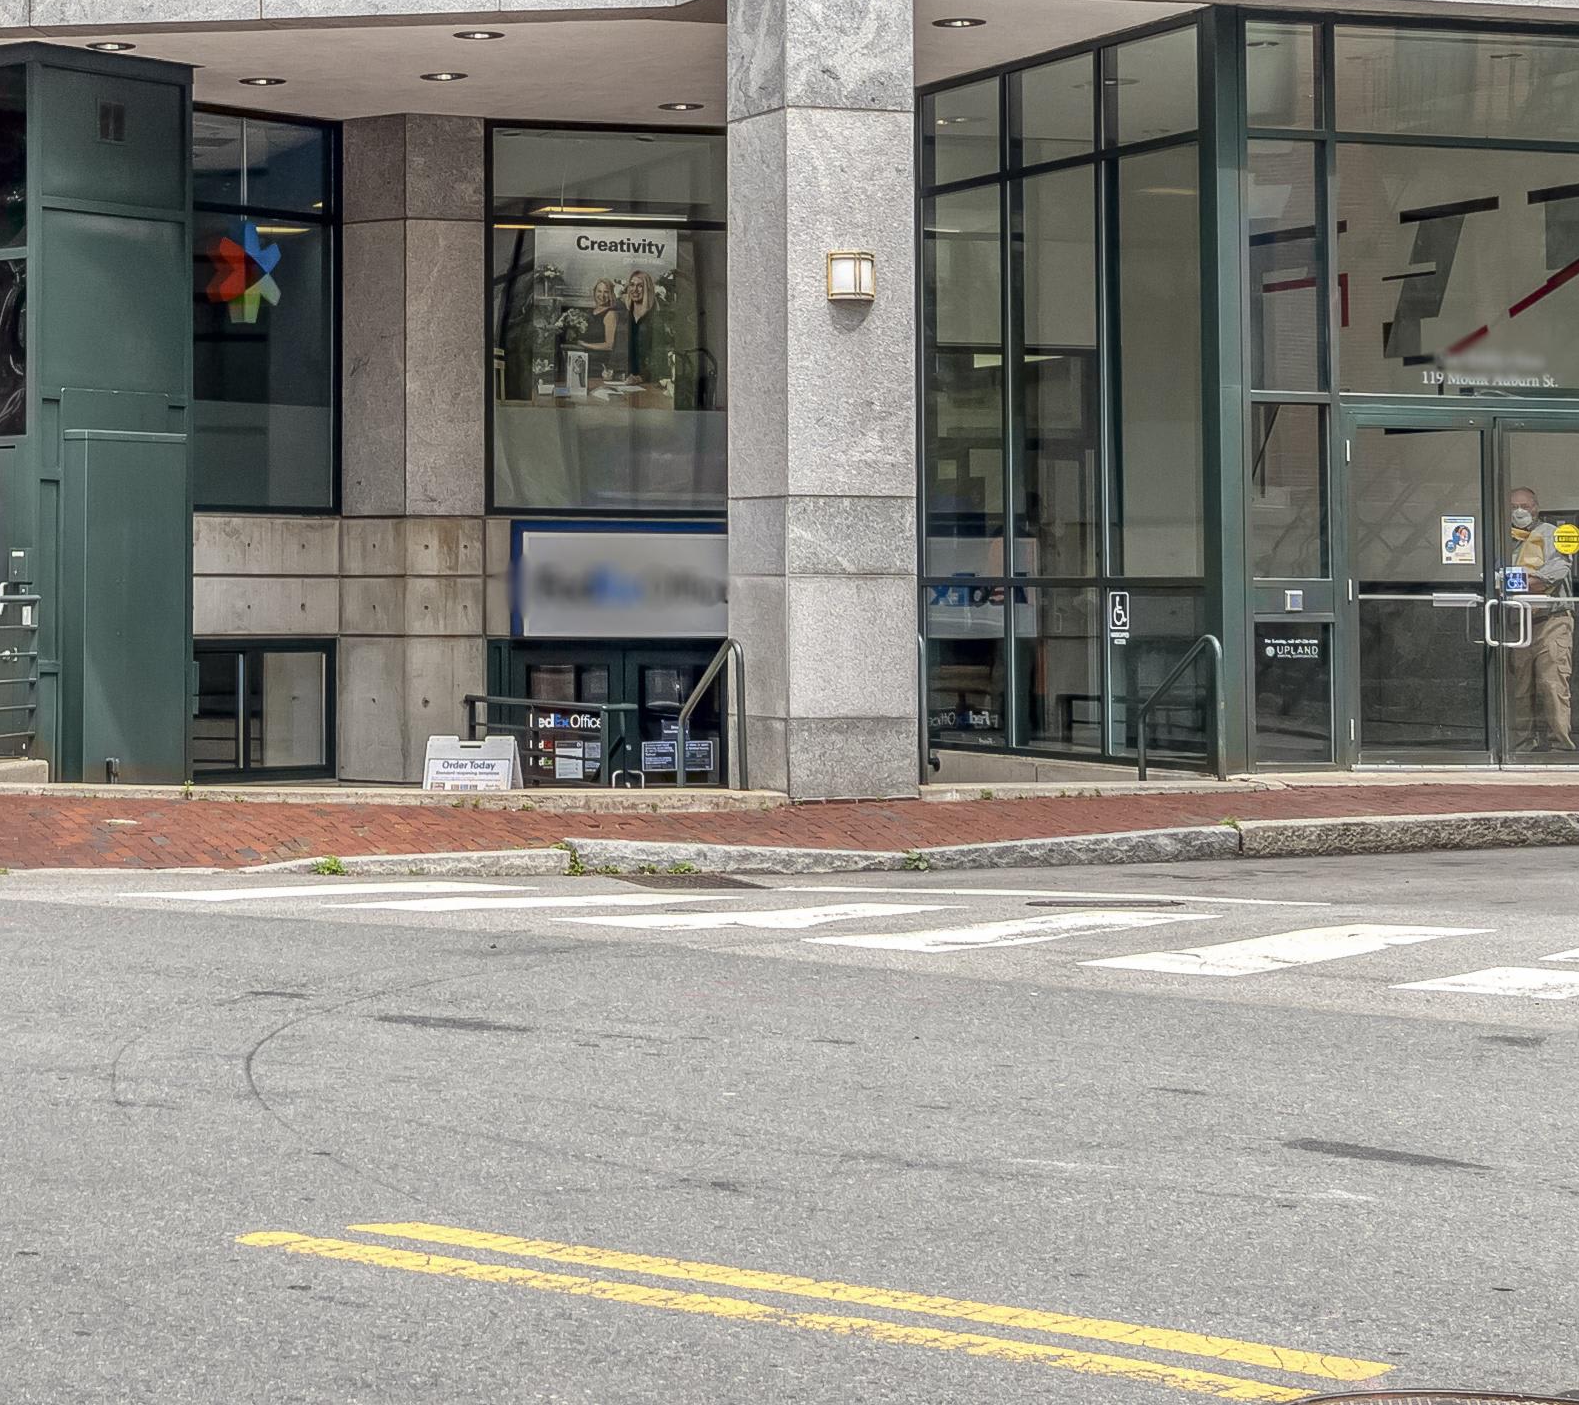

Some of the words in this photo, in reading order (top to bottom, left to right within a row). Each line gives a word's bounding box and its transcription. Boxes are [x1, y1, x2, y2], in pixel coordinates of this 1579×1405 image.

[576, 235, 665, 258] Creativity
[1422, 370, 1444, 384] 119
[1542, 374, 1559, 388] St.
[1276, 645, 1319, 655] UPLAND
[442, 760, 468, 770] Order
[470, 761, 496, 771] Today
